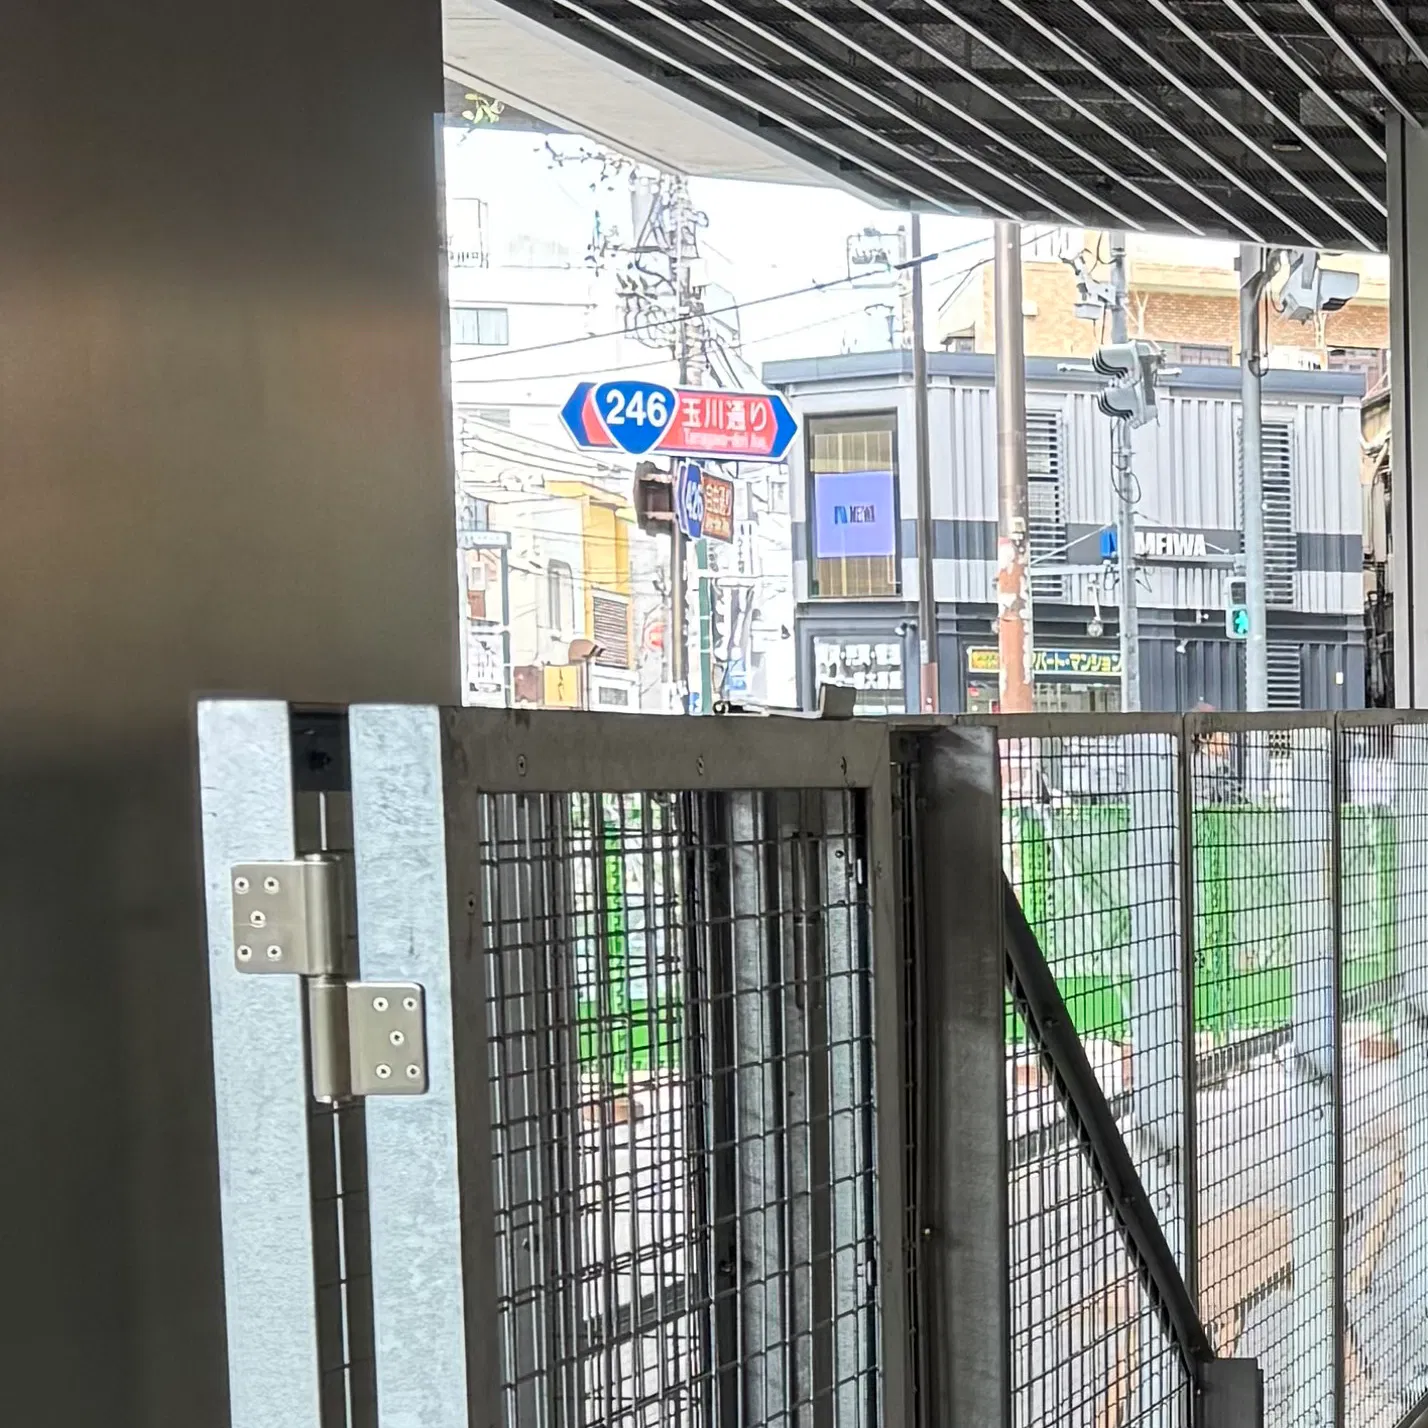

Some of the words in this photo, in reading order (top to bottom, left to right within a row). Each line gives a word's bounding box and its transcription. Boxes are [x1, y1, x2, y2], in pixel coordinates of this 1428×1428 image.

[605, 389, 668, 428] 246
[681, 397, 768, 432] 玉川通り
